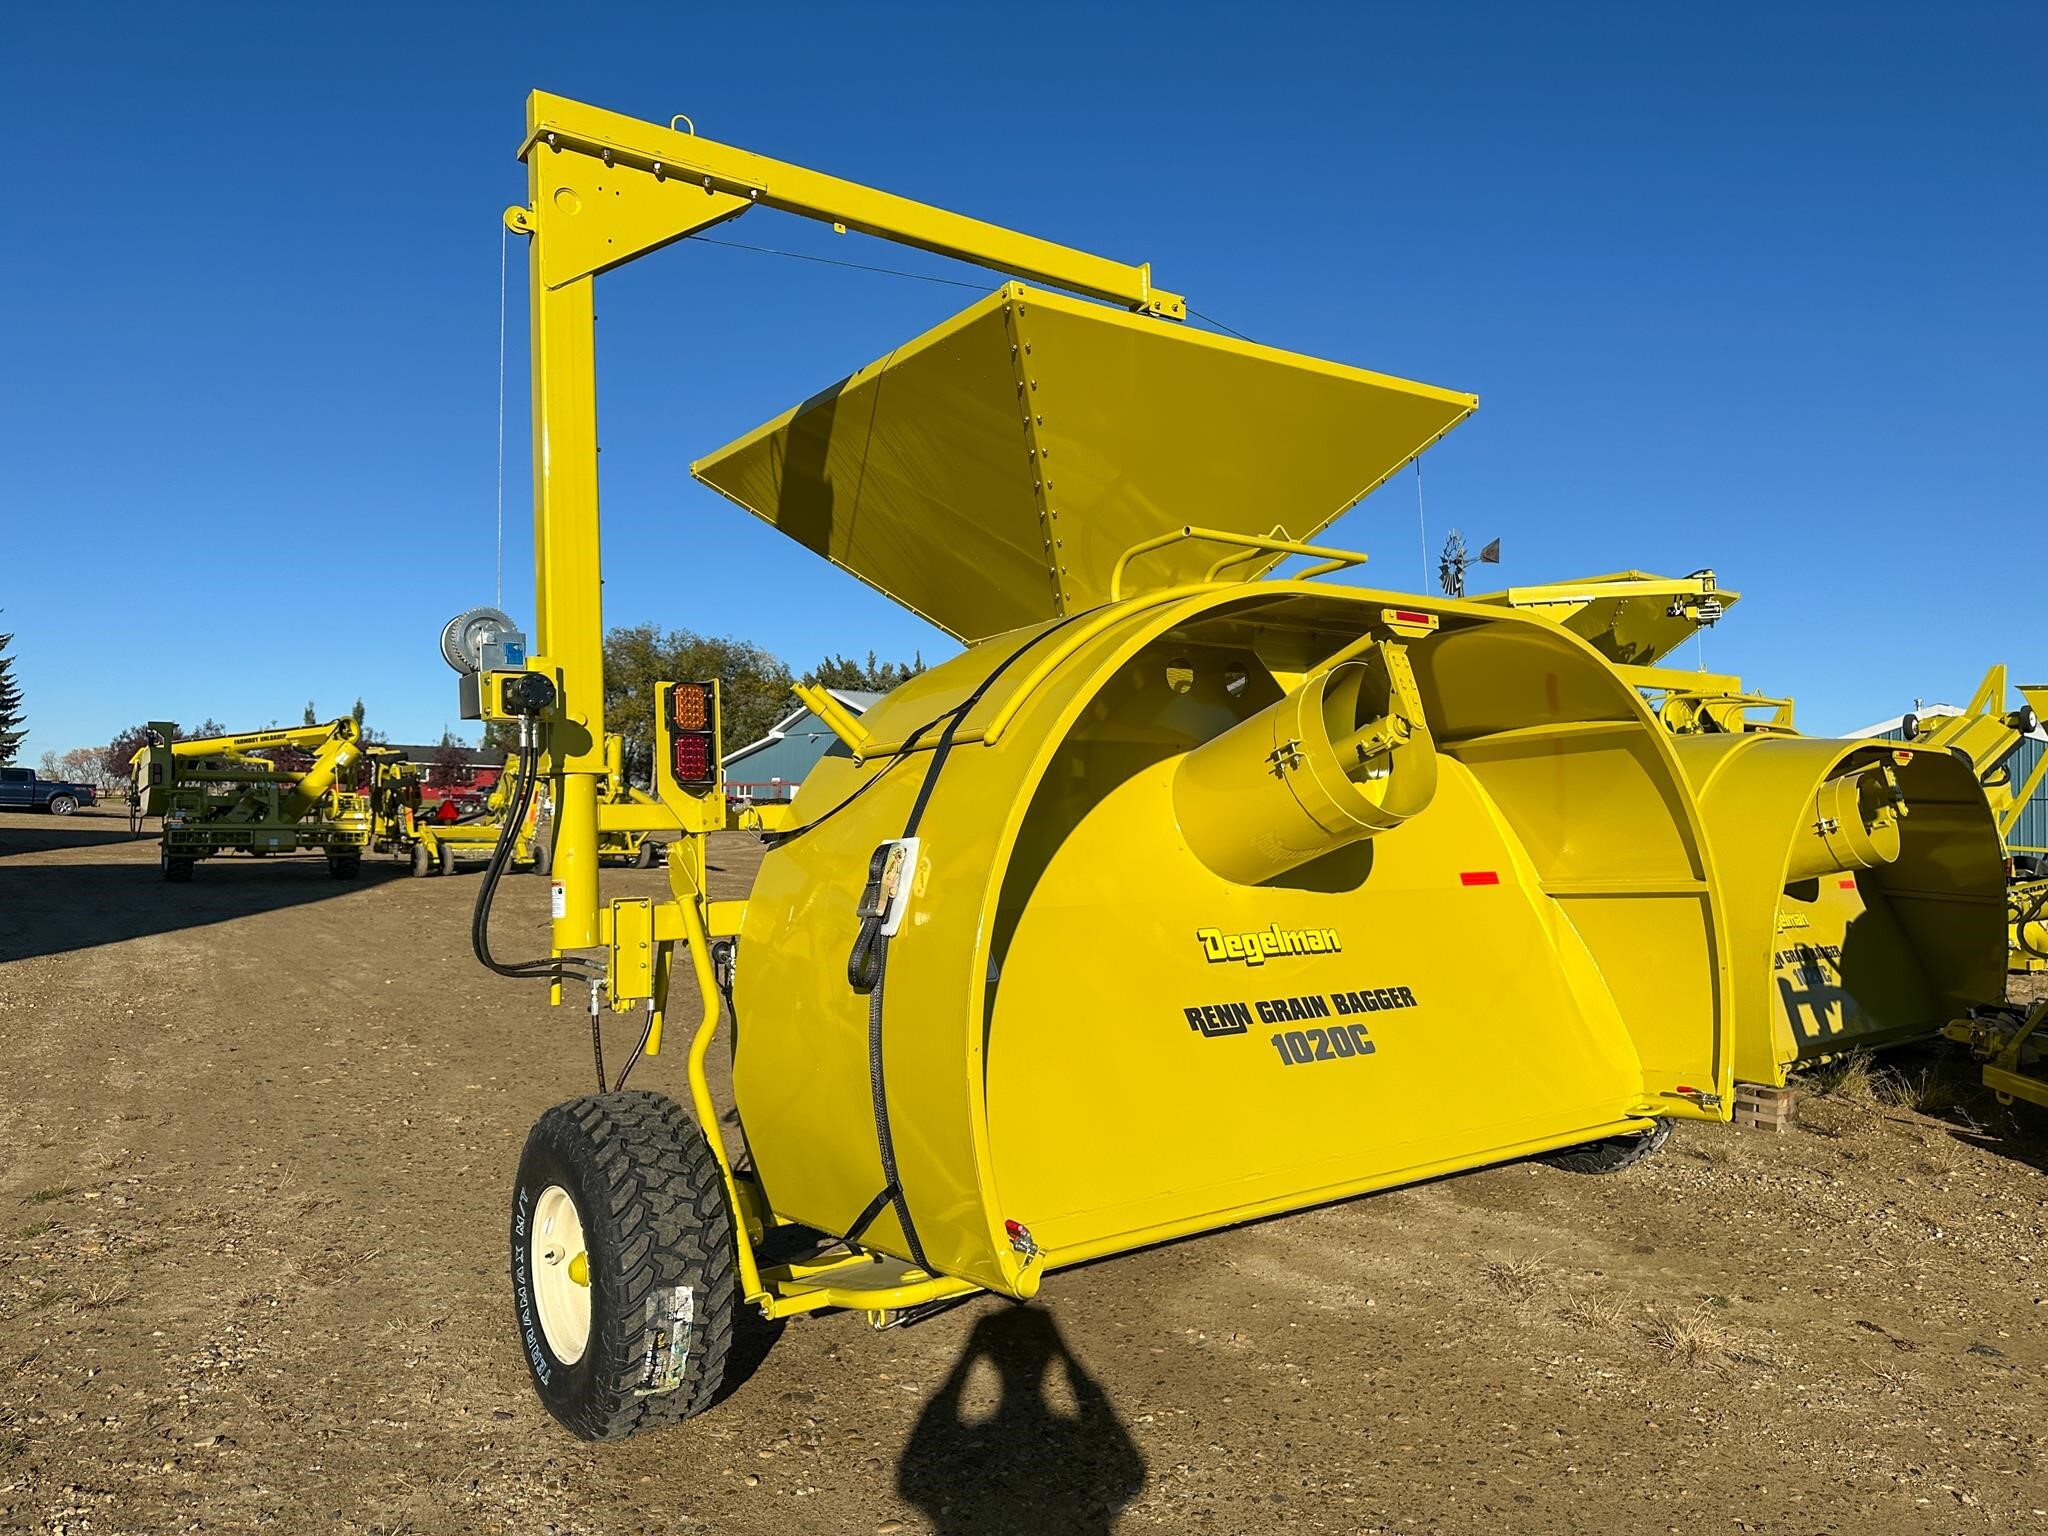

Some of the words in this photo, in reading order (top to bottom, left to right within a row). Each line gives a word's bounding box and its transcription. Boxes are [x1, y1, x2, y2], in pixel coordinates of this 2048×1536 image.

[1197, 922, 1342, 967] Degelman
[1183, 1002, 1254, 1038] RENN
[1255, 995, 1331, 1024] GRAIN
[1330, 986, 1418, 1015] BAGGER
[1270, 1024, 1376, 1066] 1020C
[515, 1245, 551, 1386] TERRAMAX
